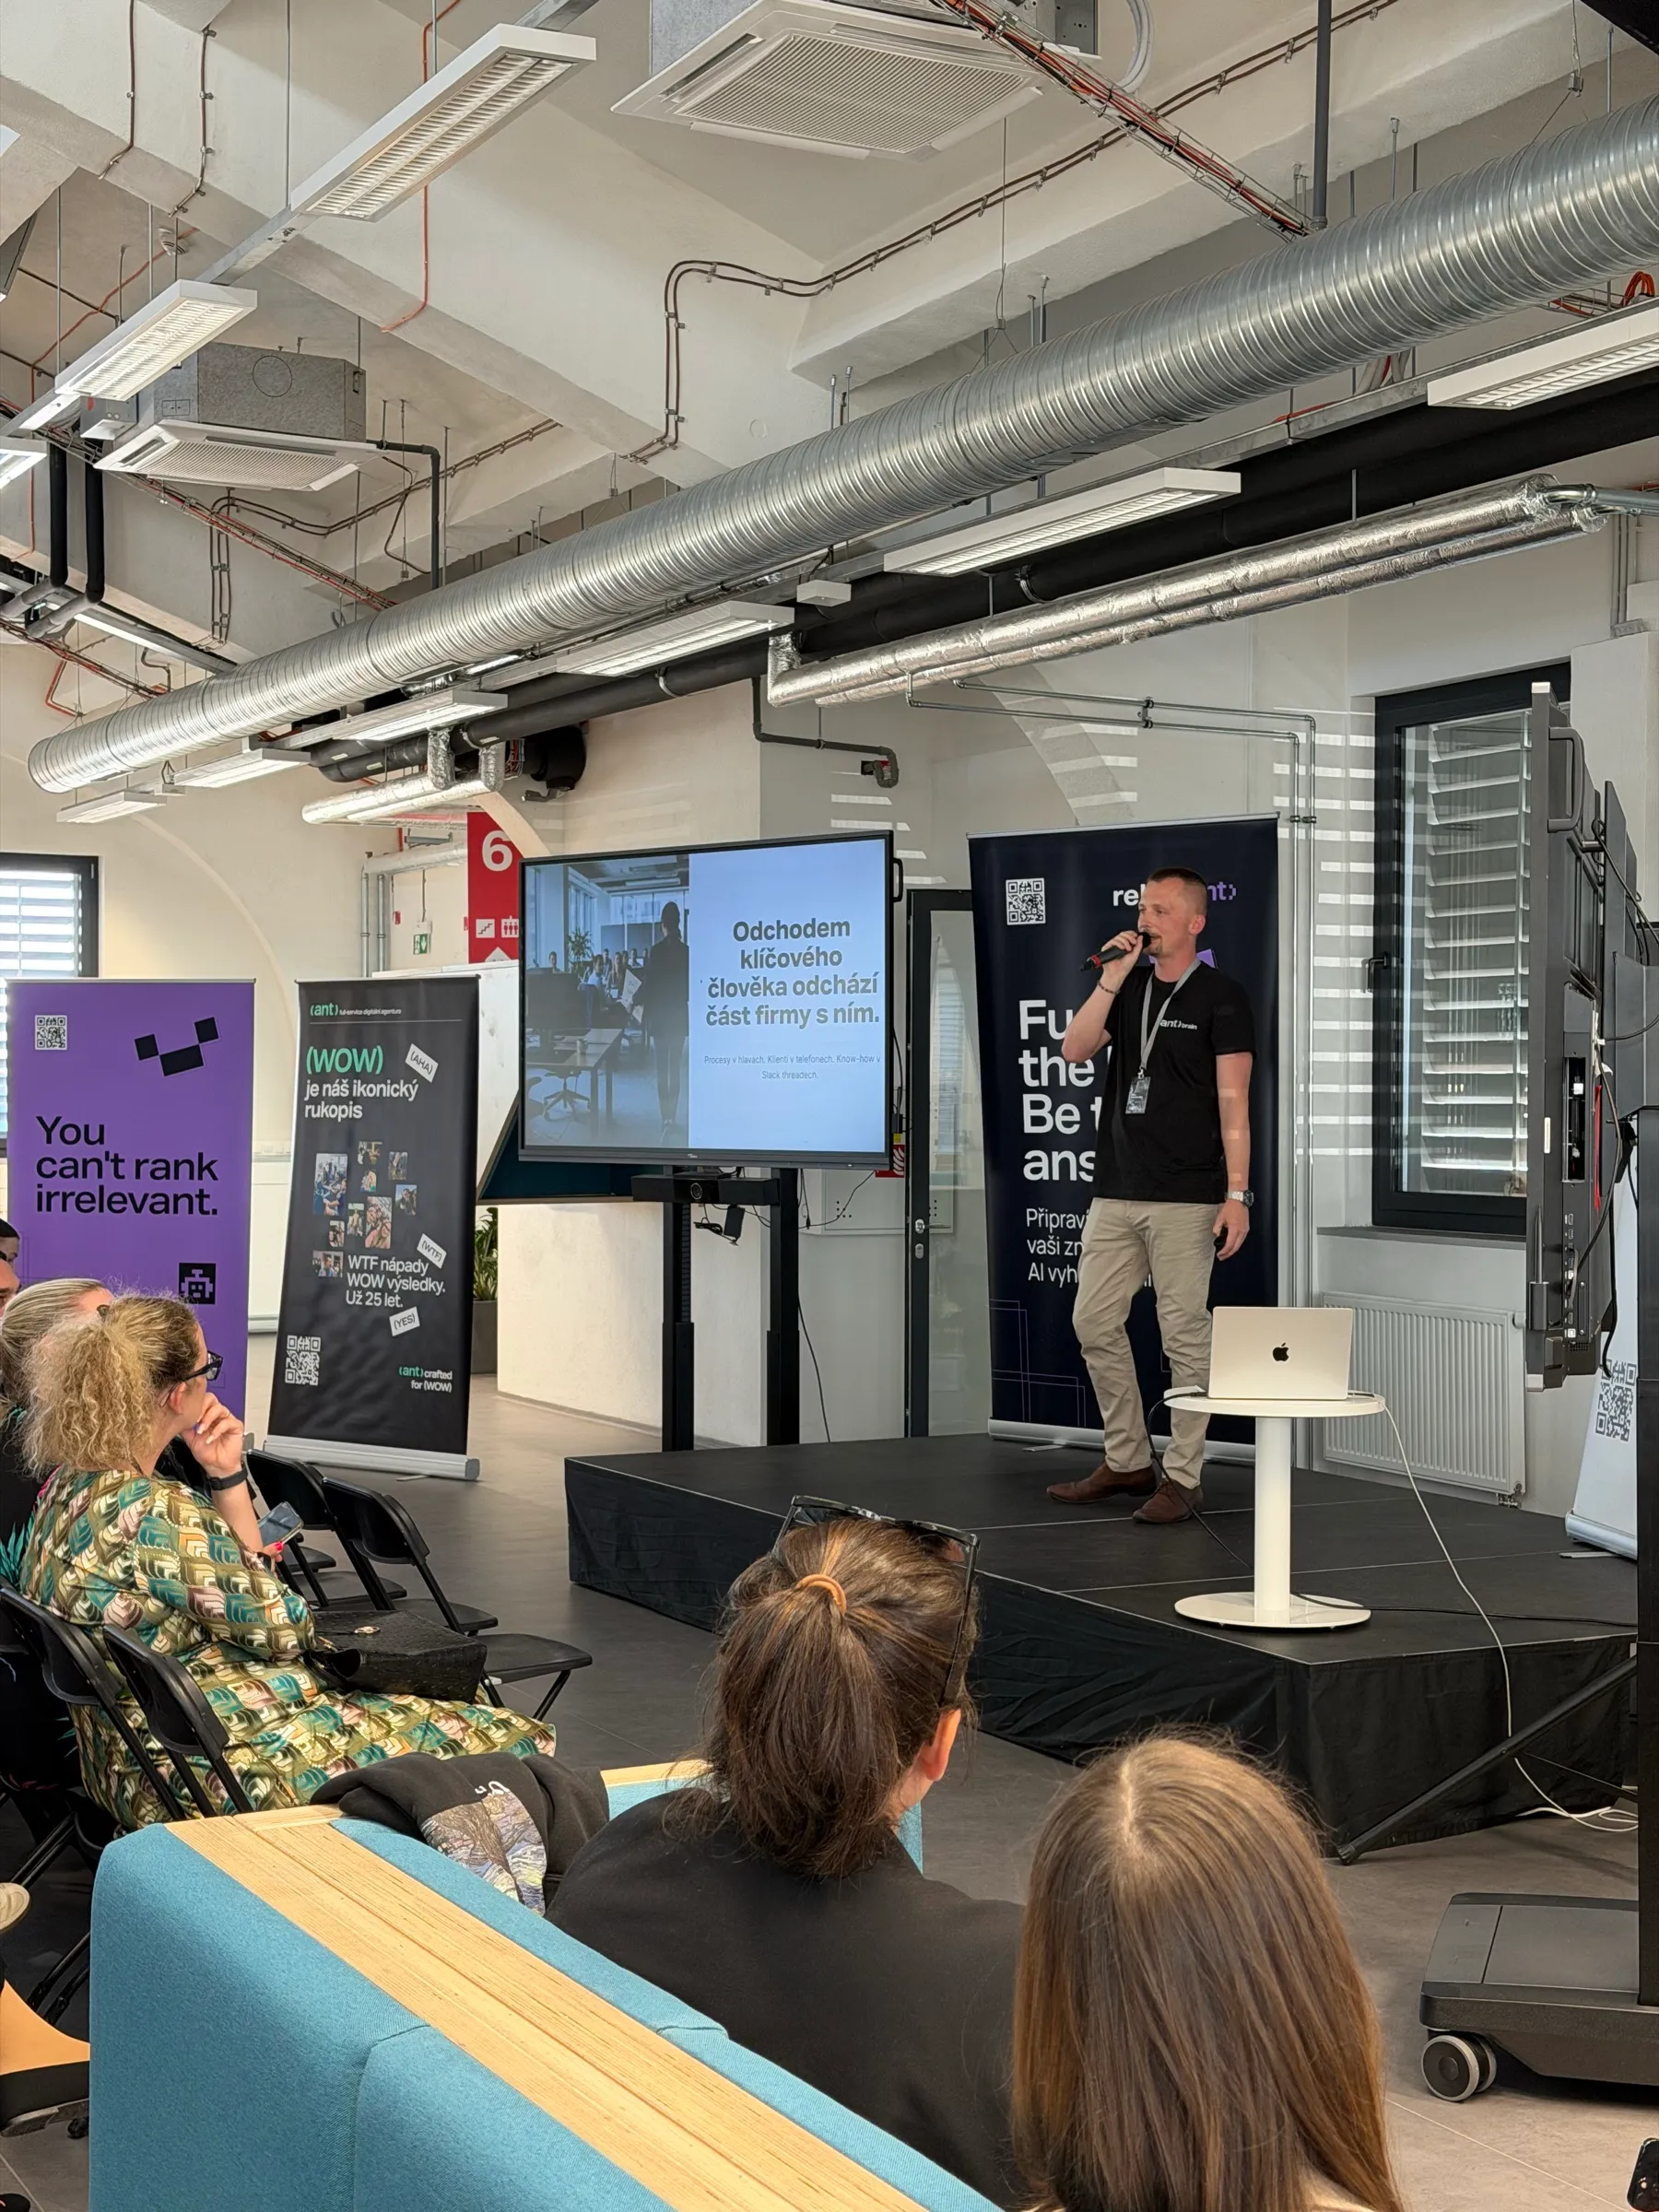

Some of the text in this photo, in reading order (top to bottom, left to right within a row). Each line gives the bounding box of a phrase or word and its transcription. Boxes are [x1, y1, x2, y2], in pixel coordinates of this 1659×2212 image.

[482, 830, 513, 872] 6
[733, 918, 851, 942] Odchodem
[740, 946, 842, 970] klíčového
[708, 971, 880, 999] člověka odchází
[310, 1002, 338, 1017] (ant)
[705, 1001, 880, 1030] část firmy s ním.
[1160, 1018, 1182, 1029] ant)
[306, 1045, 383, 1075] (WOW)
[409, 1050, 434, 1076] (AHA)
[704, 1054, 731, 1066] Procesy
[767, 1053, 789, 1064] Klienti
[796, 1053, 835, 1064] telefonech.
[836, 1053, 875, 1064] Know-how
[1018, 1046, 1095, 1088] the
[761, 1070, 818, 1080] Slack threadech.
[304, 1078, 419, 1101] je náš ikonický
[304, 1101, 363, 1123] rukopis
[1022, 1093, 1081, 1135] Be
[36, 1115, 105, 1146] You
[36, 1150, 219, 1181] can't rank
[1023, 1150, 1096, 1182] ans
[36, 1183, 218, 1216] irrelevant.
[421, 1240, 443, 1263] (WTF)
[1027, 1235, 1060, 1255] vaši
[347, 1254, 429, 1277] WTF nápady
[347, 1272, 445, 1294] WOW výsledky.
[346, 1290, 404, 1309] Už 25 let.
[393, 1312, 417, 1330] (YES)
[398, 1366, 453, 1381] (ant) crafted
[411, 1380, 453, 1393] for (WOW)
